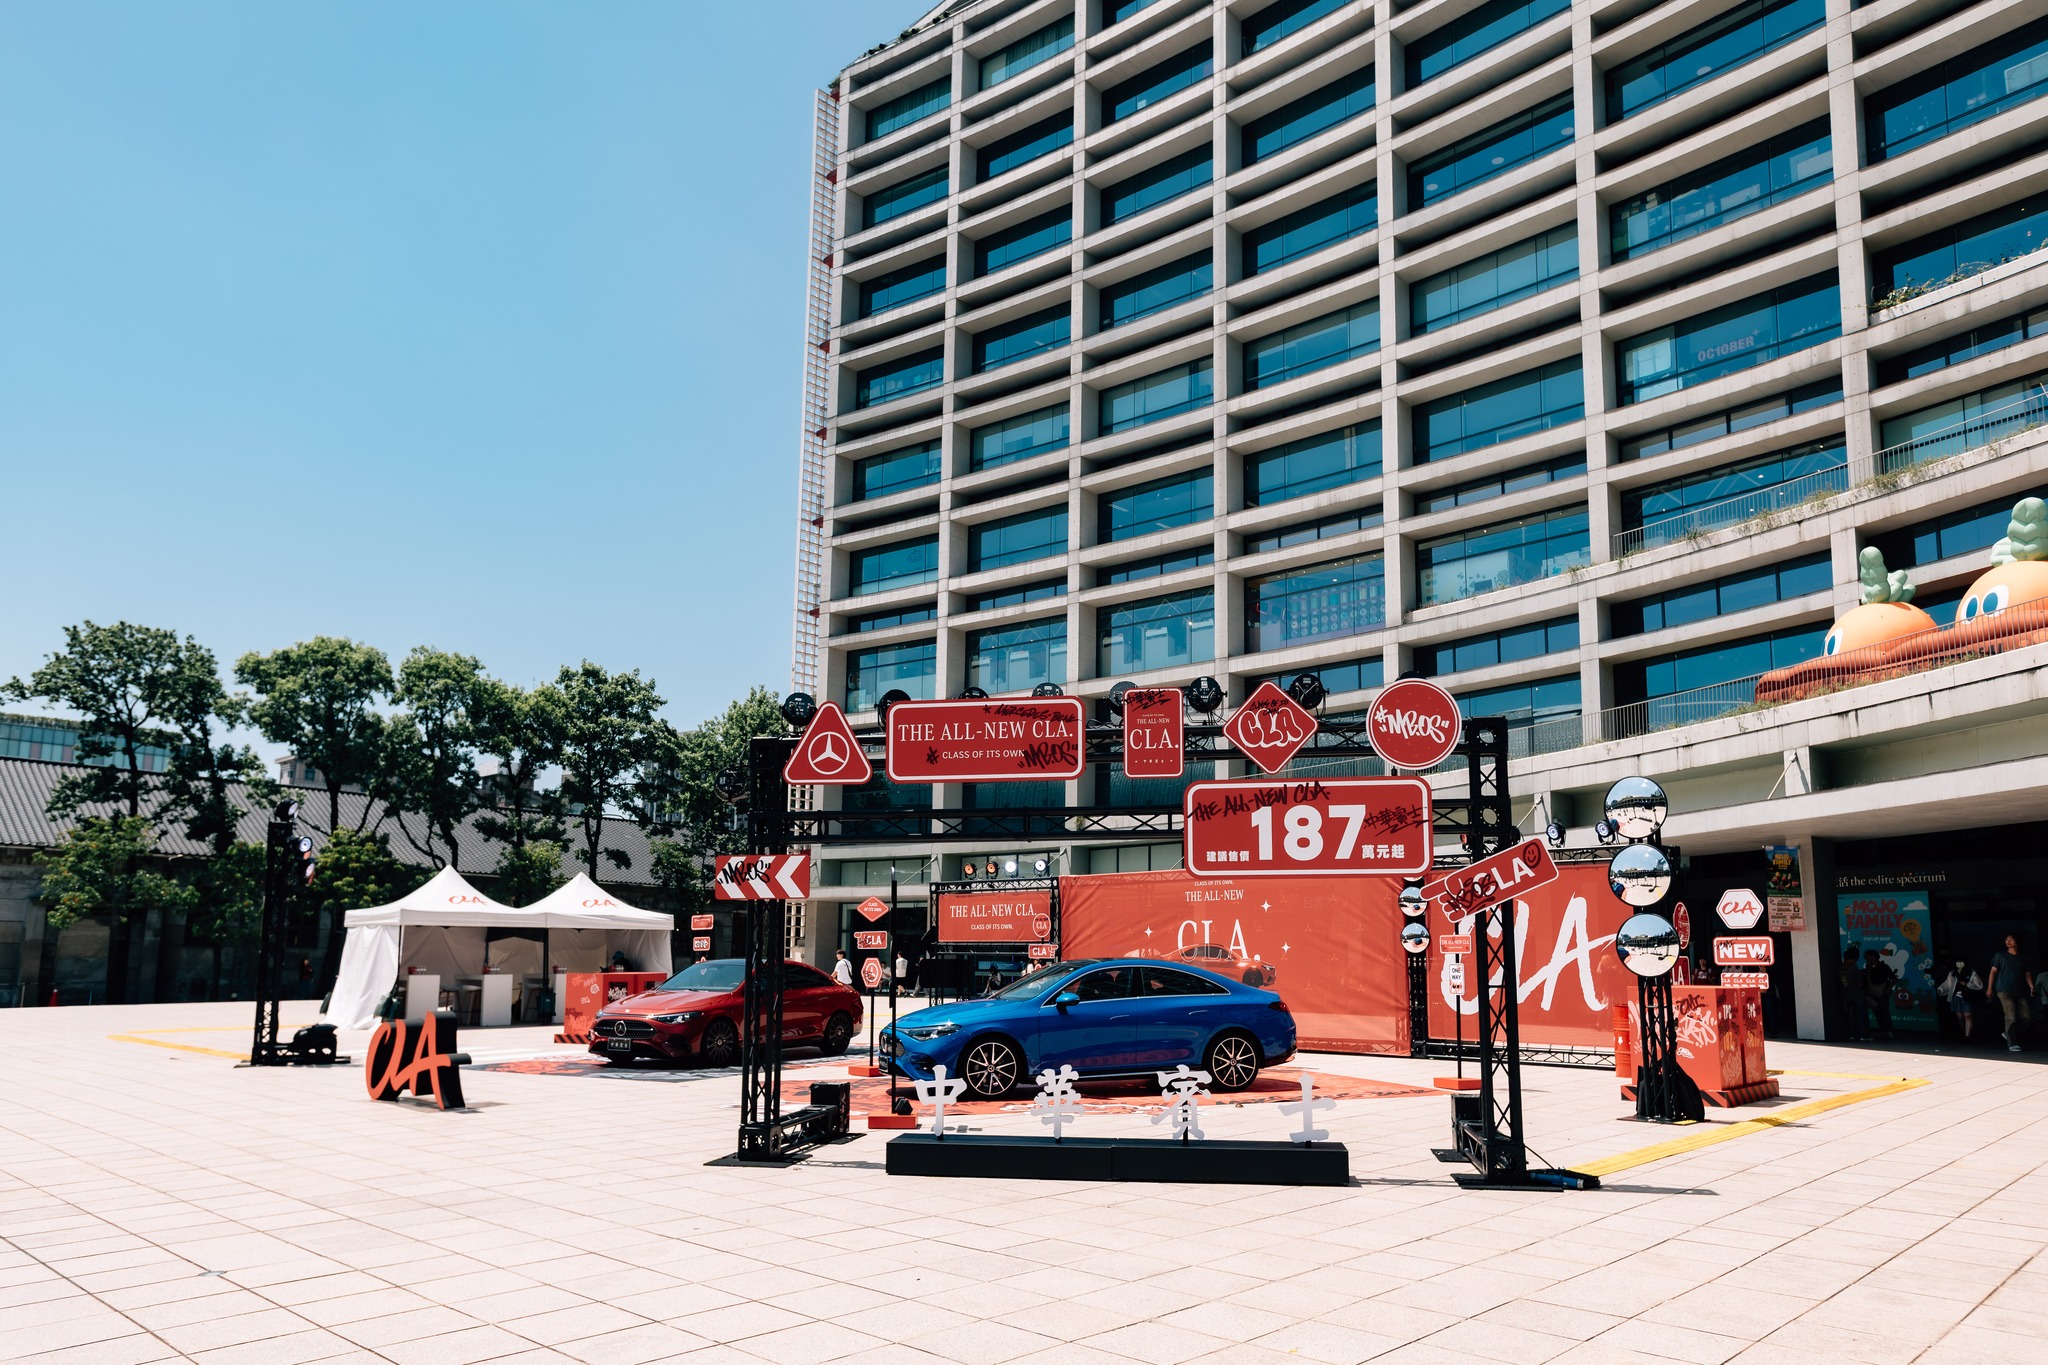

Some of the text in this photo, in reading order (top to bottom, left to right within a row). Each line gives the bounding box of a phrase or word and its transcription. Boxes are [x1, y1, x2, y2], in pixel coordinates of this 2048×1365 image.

[898, 720, 1074, 742] THE ALL-NEW CLA.
[1238, 707, 1303, 749] CLA
[1130, 728, 1179, 750] CLA.
[942, 750, 970, 759] CLASS
[972, 750, 983, 759] OF
[986, 749, 1000, 758] ITS
[1251, 804, 1367, 861] 187
[1207, 844, 1405, 862] 建議售價 萬元起
[1472, 857, 1536, 897] CLA
[1850, 876, 1866, 886] the
[1868, 875, 1895, 885] eslite
[1896, 873, 1946, 887] spectrum
[1185, 889, 1244, 901] THE ALL-NEW
[950, 903, 1037, 918] THE ALL-NEW CLA.
[1722, 901, 1757, 916] CLA
[1853, 899, 1898, 914] MOJO
[1847, 913, 1905, 929] FAMILY
[866, 935, 882, 945] CLA
[1177, 919, 1261, 963] CLA.
[1032, 947, 1047, 956] CLA
[1720, 943, 1766, 959] NEW
[366, 1011, 452, 1110] CLA
[913, 1064, 1337, 1144] 中華賓士
